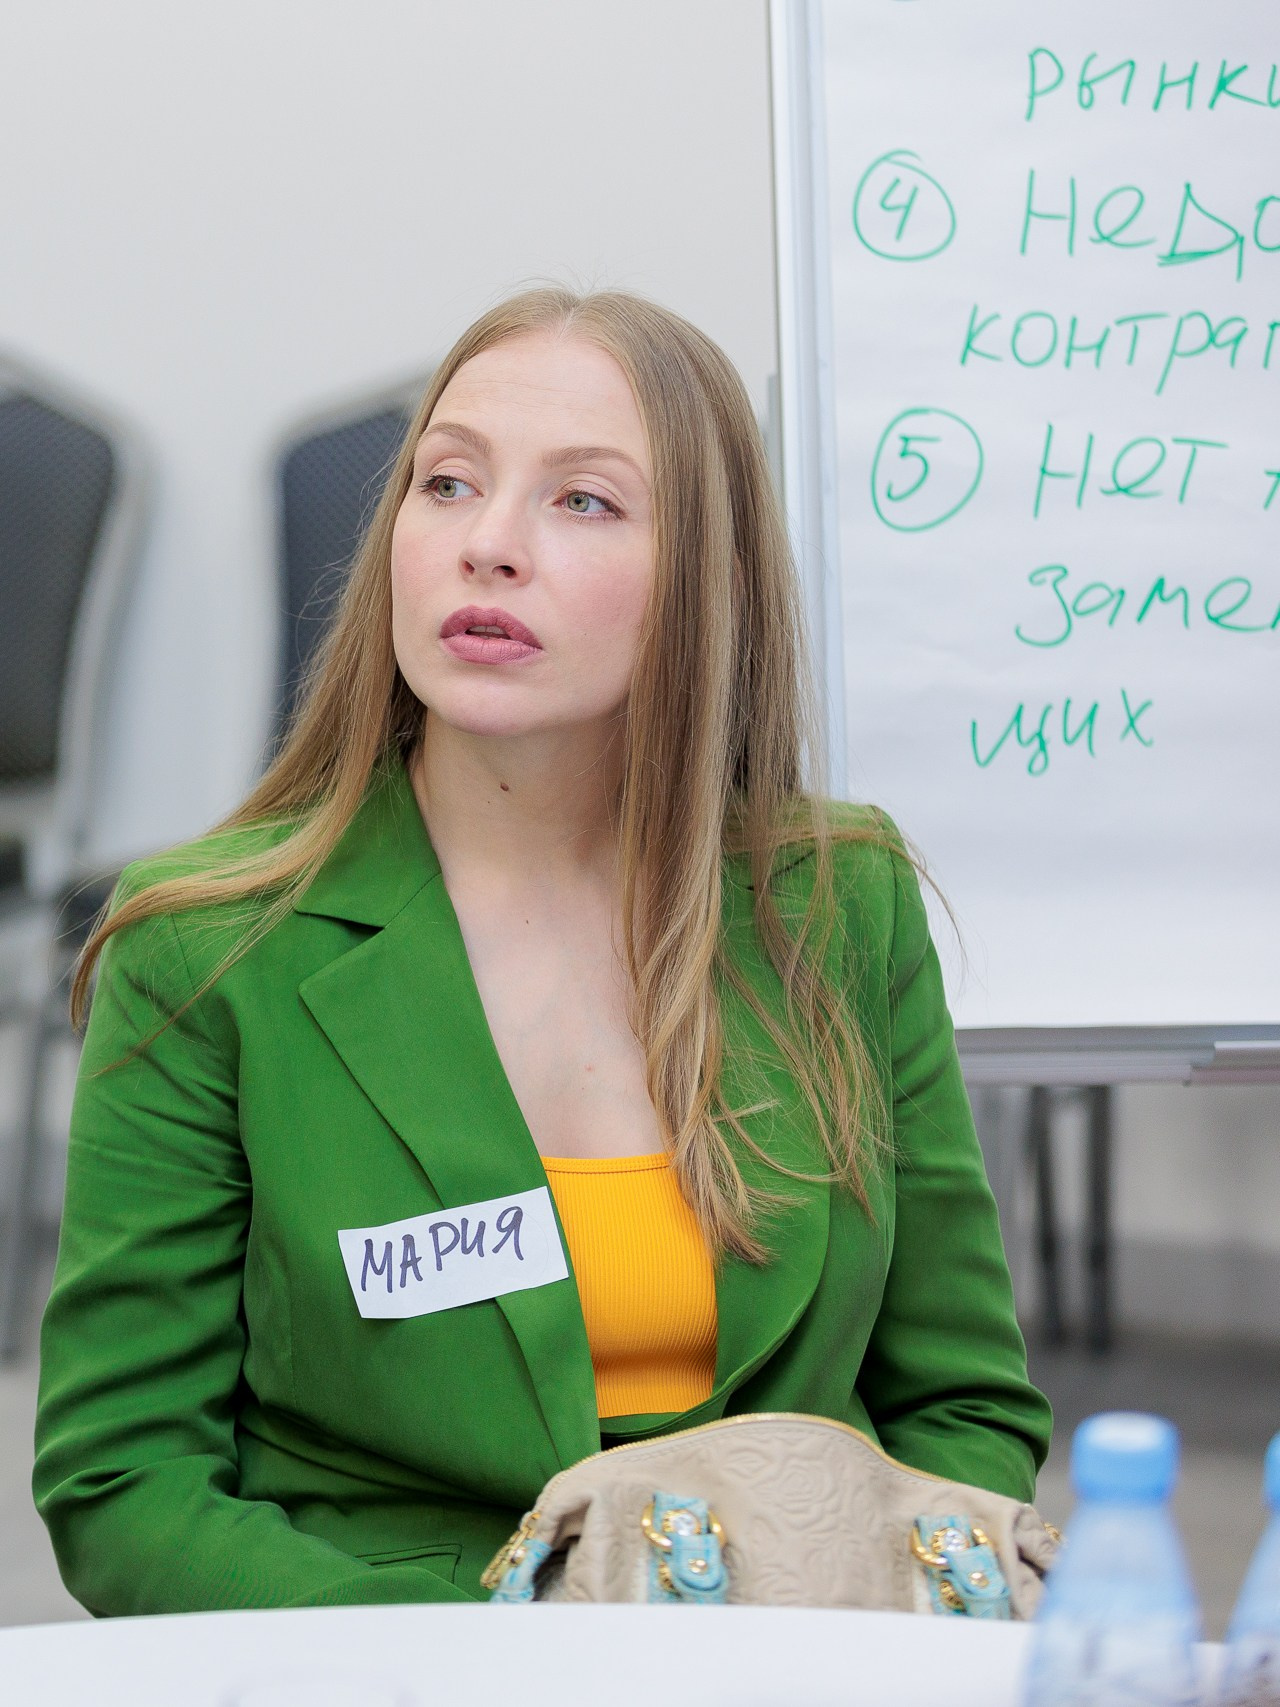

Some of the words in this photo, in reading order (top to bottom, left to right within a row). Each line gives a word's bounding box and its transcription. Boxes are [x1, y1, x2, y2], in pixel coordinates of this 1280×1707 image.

[1034, 422, 1230, 520] Нет
[1015, 564, 1280, 649] заме
[360, 1205, 524, 1294] МАРИЯ
